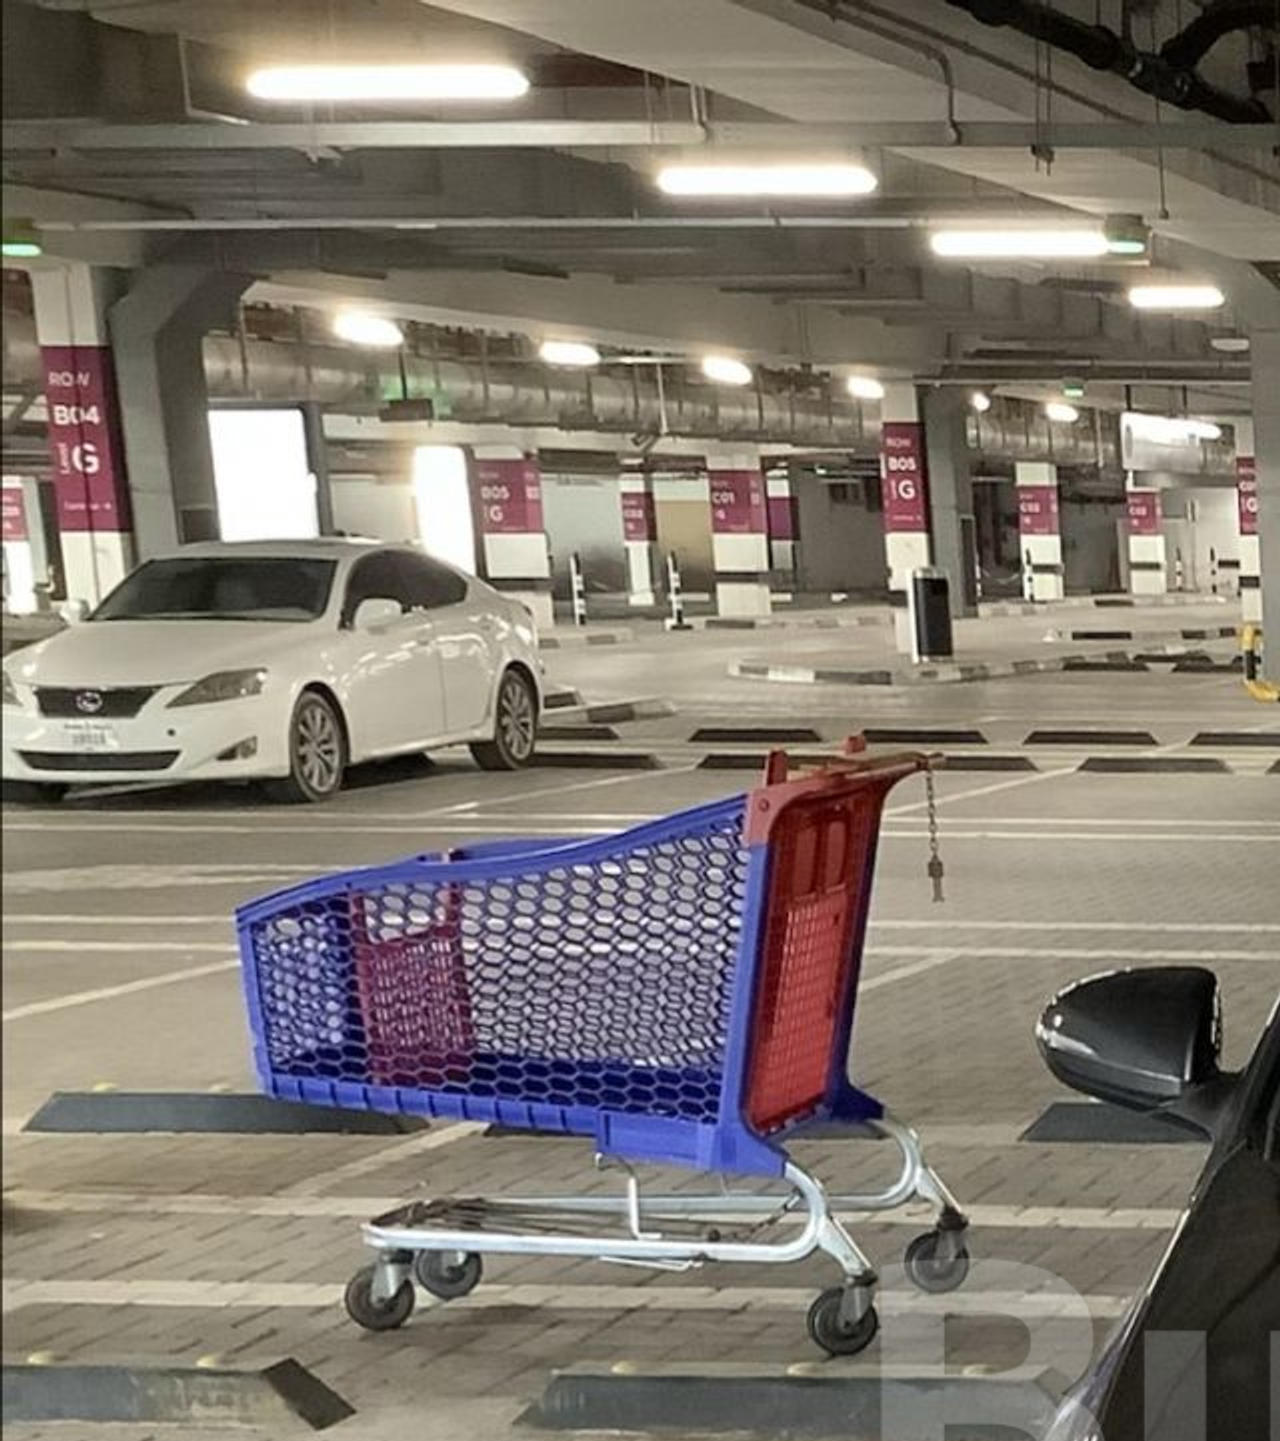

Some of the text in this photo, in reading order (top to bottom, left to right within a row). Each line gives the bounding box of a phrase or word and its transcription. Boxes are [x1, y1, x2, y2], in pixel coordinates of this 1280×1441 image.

[48, 371, 91, 388] ROW
[53, 405, 101, 426] B04
[71, 443, 100, 474] G
[898, 480, 916, 500] G
[489, 505, 504, 522] G
